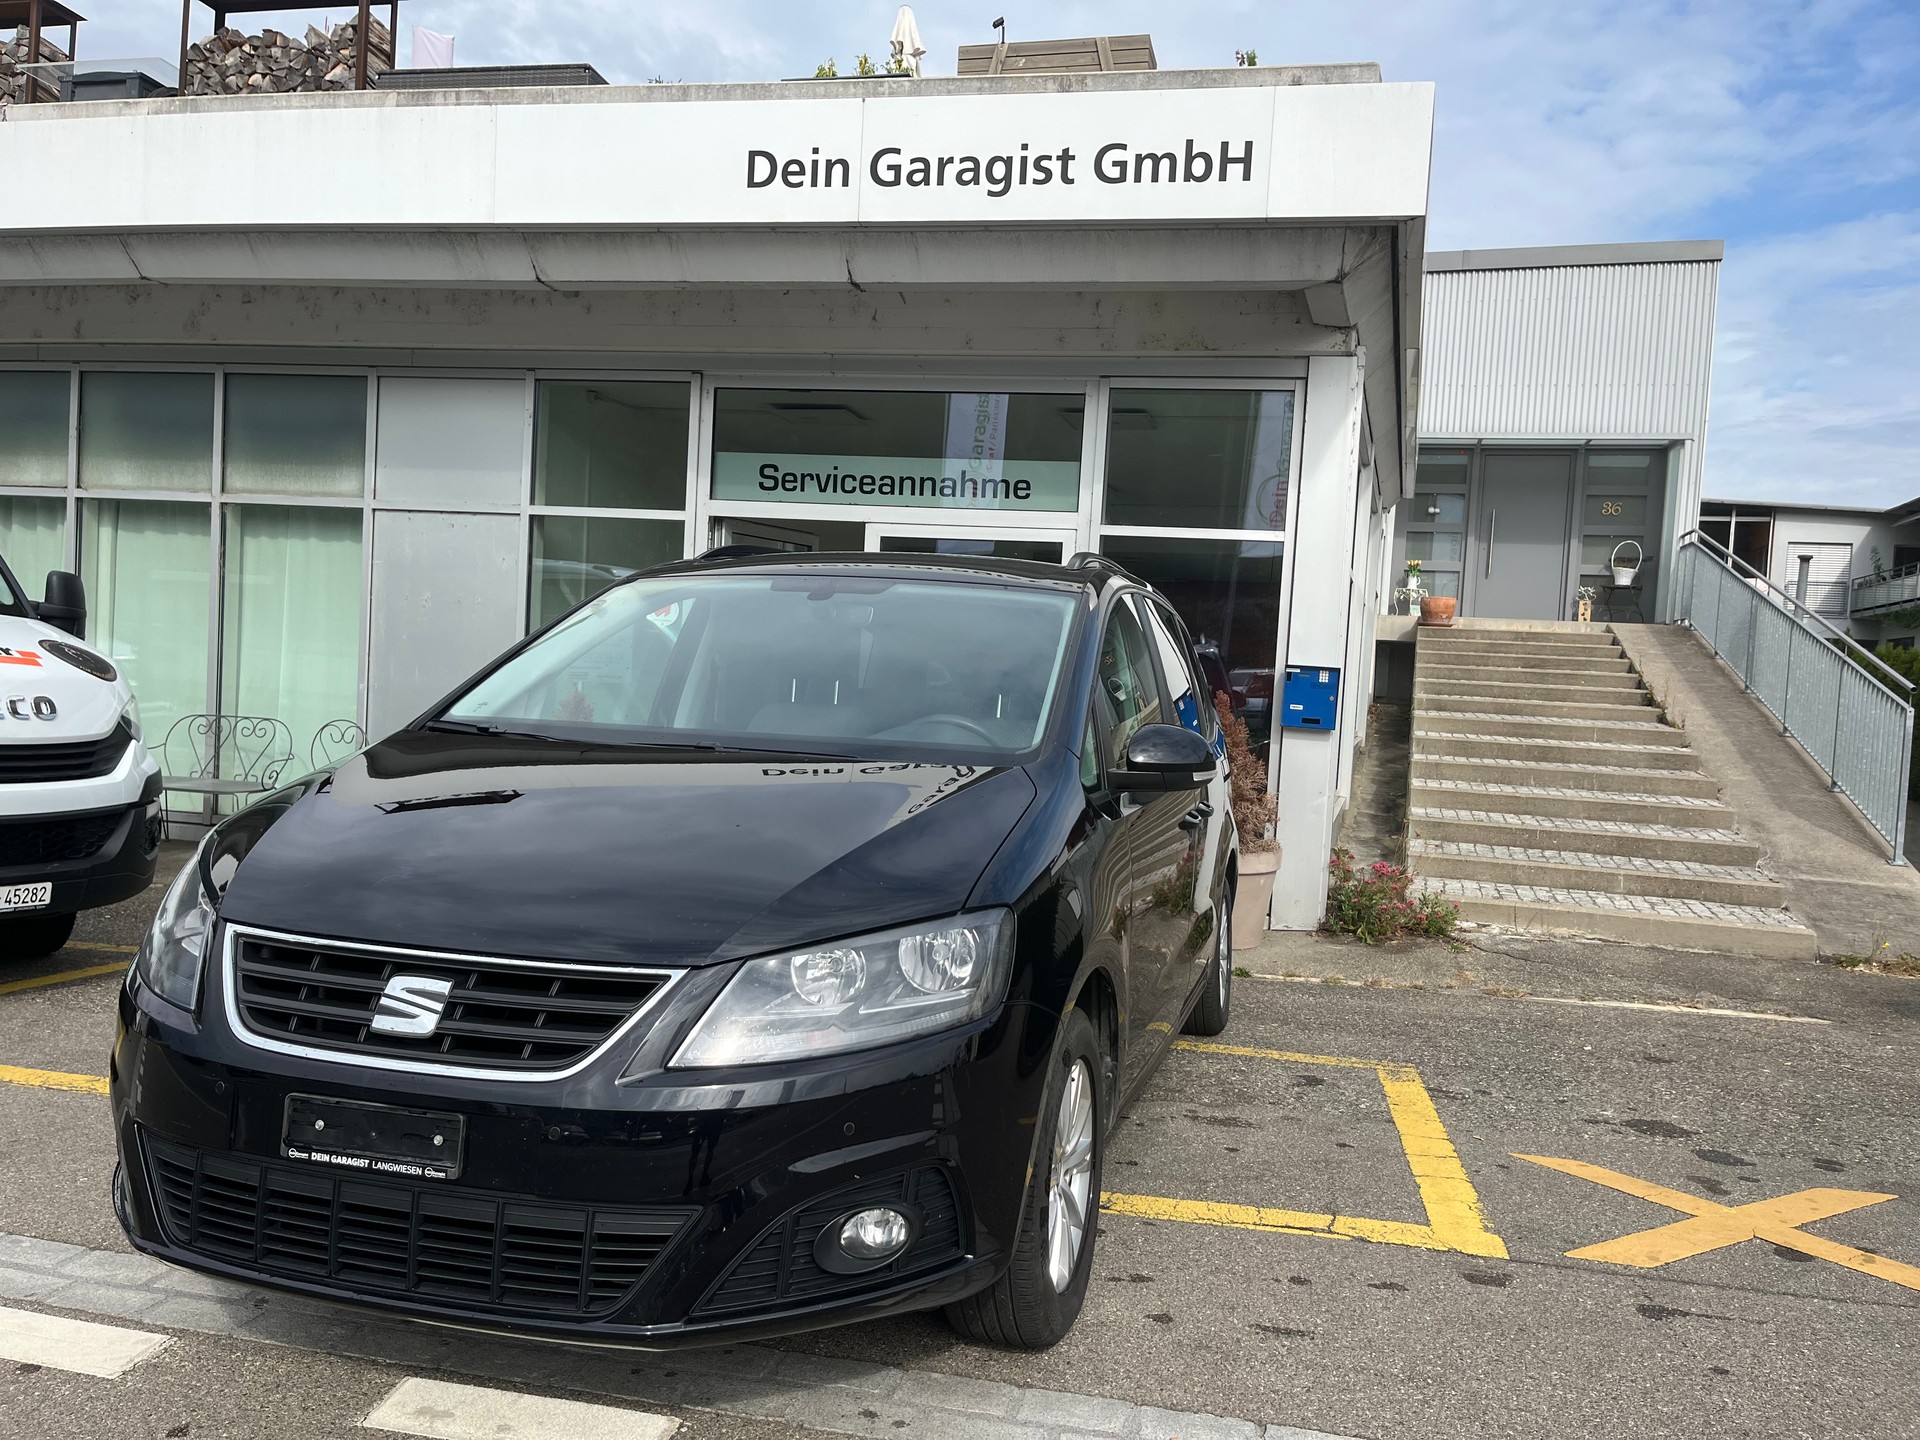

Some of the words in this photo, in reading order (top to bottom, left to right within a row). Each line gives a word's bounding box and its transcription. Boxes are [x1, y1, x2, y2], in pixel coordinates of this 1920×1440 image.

[746, 147, 850, 189] Dein
[868, 143, 1076, 198] Garagist
[1093, 139, 1254, 184] GmbH
[757, 463, 1032, 500] Serviceannahme
[1601, 501, 1623, 517] 36
[0, 694, 57, 721] CO
[4, 886, 47, 906] 45282
[311, 1151, 330, 1162] DEIN
[330, 1154, 370, 1168] GARAGIST
[372, 1160, 423, 1175] LANGWIESEN
